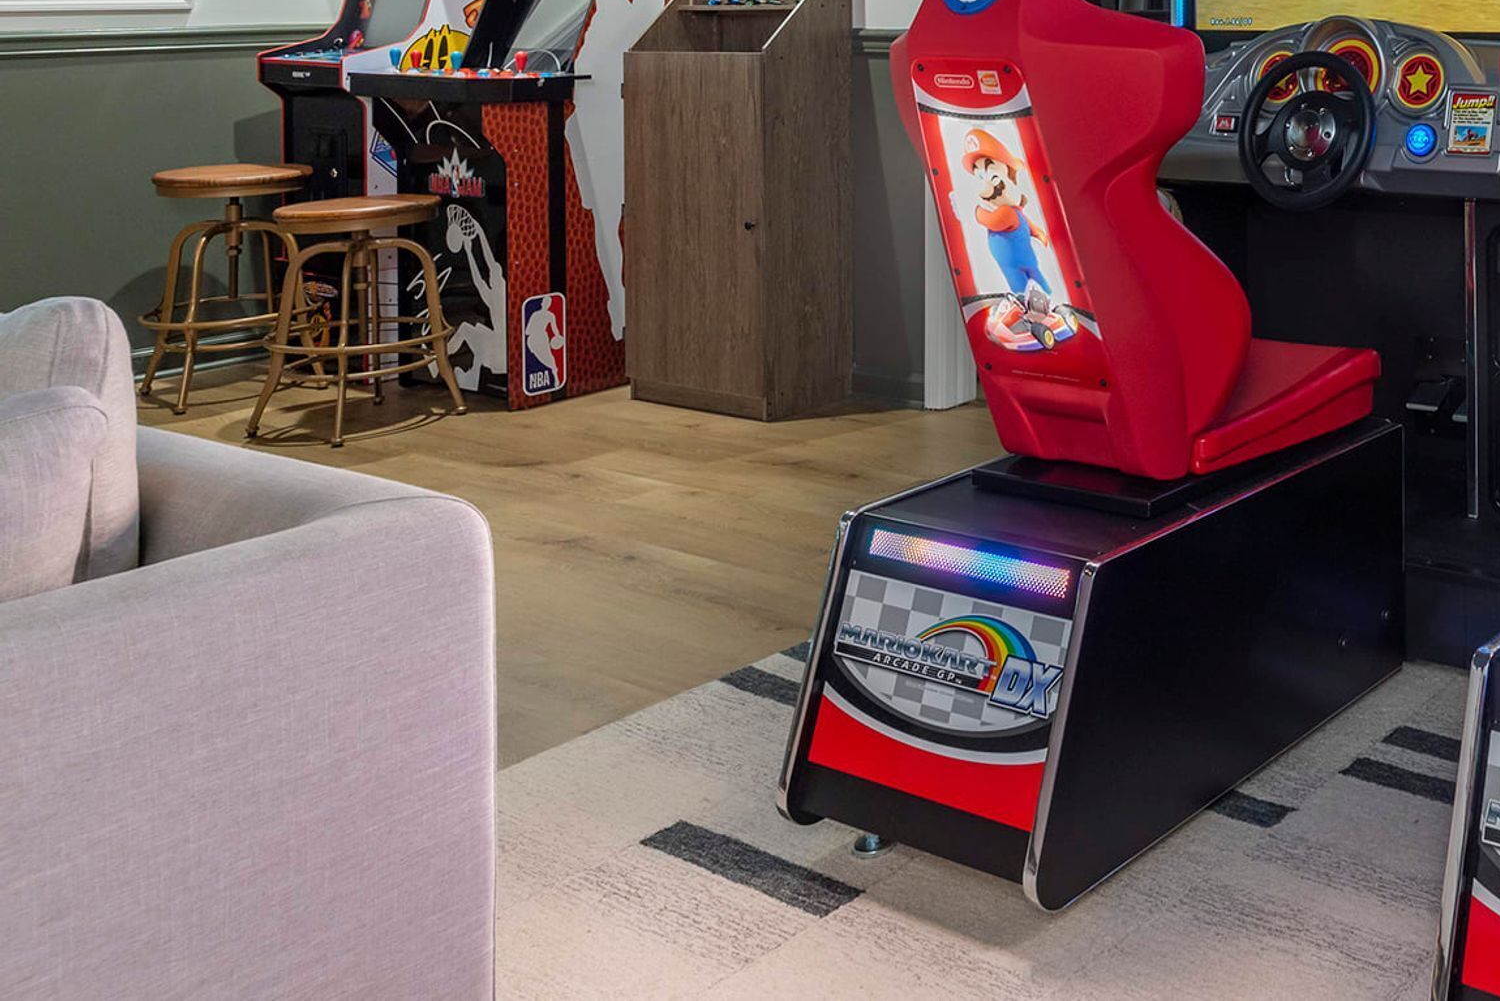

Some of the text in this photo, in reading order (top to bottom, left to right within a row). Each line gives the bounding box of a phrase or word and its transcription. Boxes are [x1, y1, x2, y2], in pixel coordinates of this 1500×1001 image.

[1452, 94, 1496, 109] Jump!!
[429, 172, 451, 194] NBA
[529, 371, 550, 389] NBA
[872, 652, 957, 683] ARCADE GP
[991, 655, 1065, 716] DX
